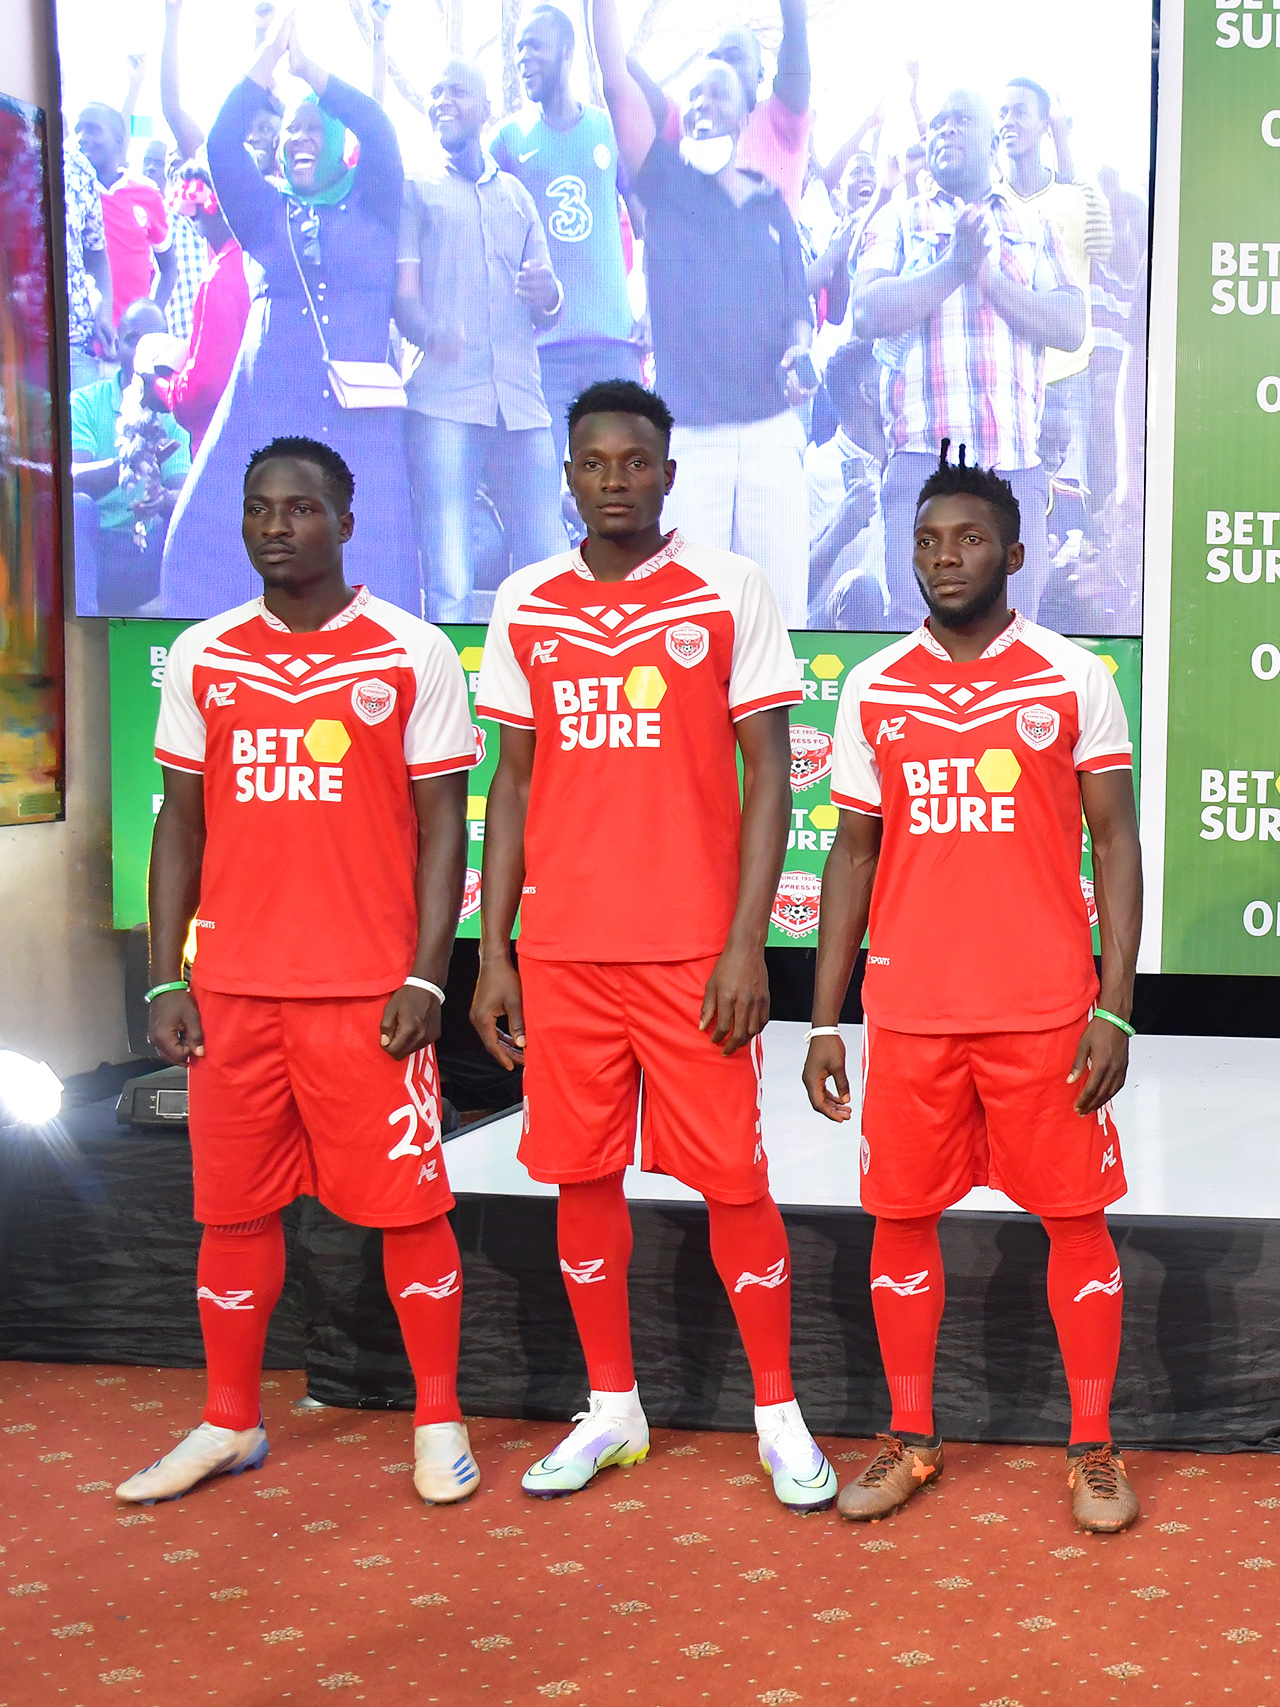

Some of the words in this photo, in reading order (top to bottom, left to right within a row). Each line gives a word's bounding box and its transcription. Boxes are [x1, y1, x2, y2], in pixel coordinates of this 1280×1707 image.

[546, 175, 593, 242] 3
[1207, 511, 1280, 545] BET
[553, 677, 624, 714] BET
[802, 680, 839, 701] RE
[233, 729, 304, 765] BET
[558, 712, 660, 750] SURE
[236, 766, 343, 802] SURE
[902, 758, 975, 797] BET
[1201, 769, 1274, 803] BET
[909, 797, 1014, 834] SURE
